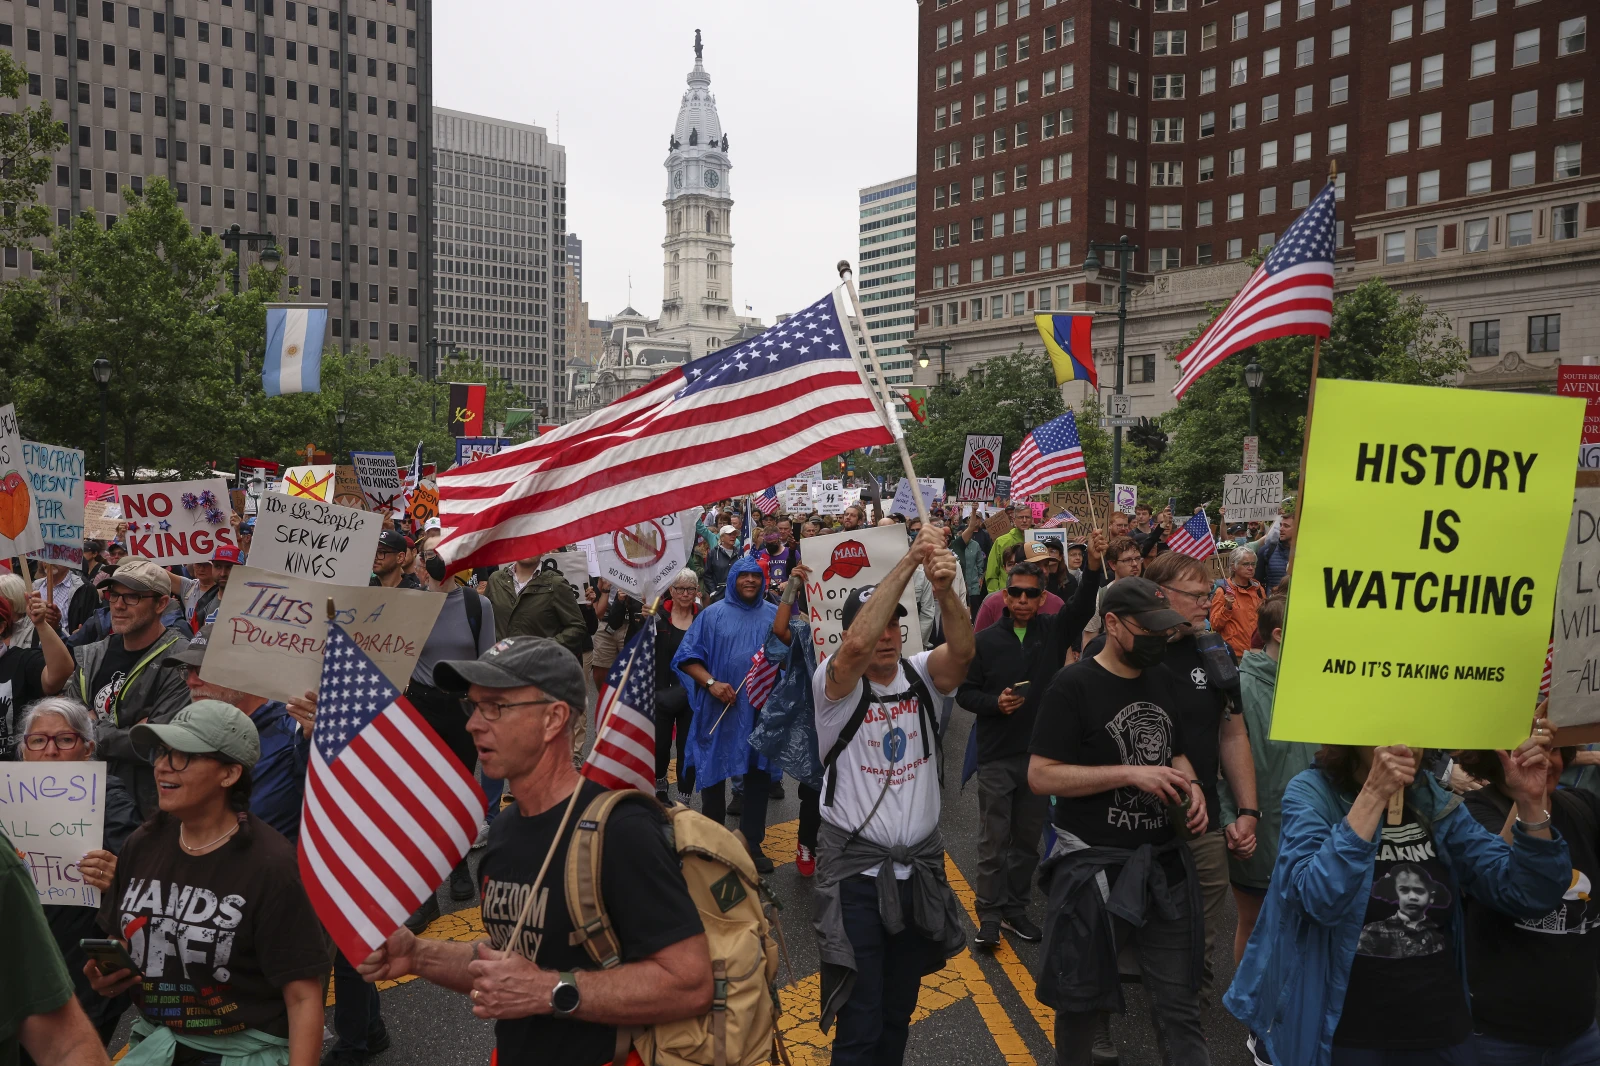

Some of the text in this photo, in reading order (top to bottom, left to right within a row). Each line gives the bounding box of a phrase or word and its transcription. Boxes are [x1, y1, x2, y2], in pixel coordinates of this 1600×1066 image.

[969, 436, 987, 452] FUCK
[22, 444, 84, 476] EMOCRACY
[357, 457, 396, 468] NO THRONES
[358, 466, 398, 477] NO CROWNS
[1355, 442, 1538, 493] HISTORY
[361, 476, 400, 489] NO KINGS
[958, 472, 997, 500] LOSERS
[1233, 473, 1280, 487] 250 YEARS
[122, 492, 173, 519] NO
[1056, 493, 1109, 507] FASCISTS
[1249, 507, 1267, 519] THAT
[266, 496, 287, 514] We
[308, 504, 365, 533] People
[130, 528, 233, 559] KINGS
[275, 524, 349, 553] SERVE NO
[1419, 509, 1461, 554] IS
[285, 551, 338, 578] KINGS
[834, 546, 866, 561] MAGA
[242, 581, 313, 624] THIS
[1323, 567, 1535, 616] WATCHING
[362, 603, 387, 623] A
[228, 617, 416, 656] POWERFU PARADE
[1322, 658, 1506, 682] AND IT'S TAKING NAMES
[1107, 807, 1148, 831] EAT
[1142, 817, 1163, 830] THE
[120, 877, 246, 929] HANDS
[121, 912, 236, 982] OFF!
